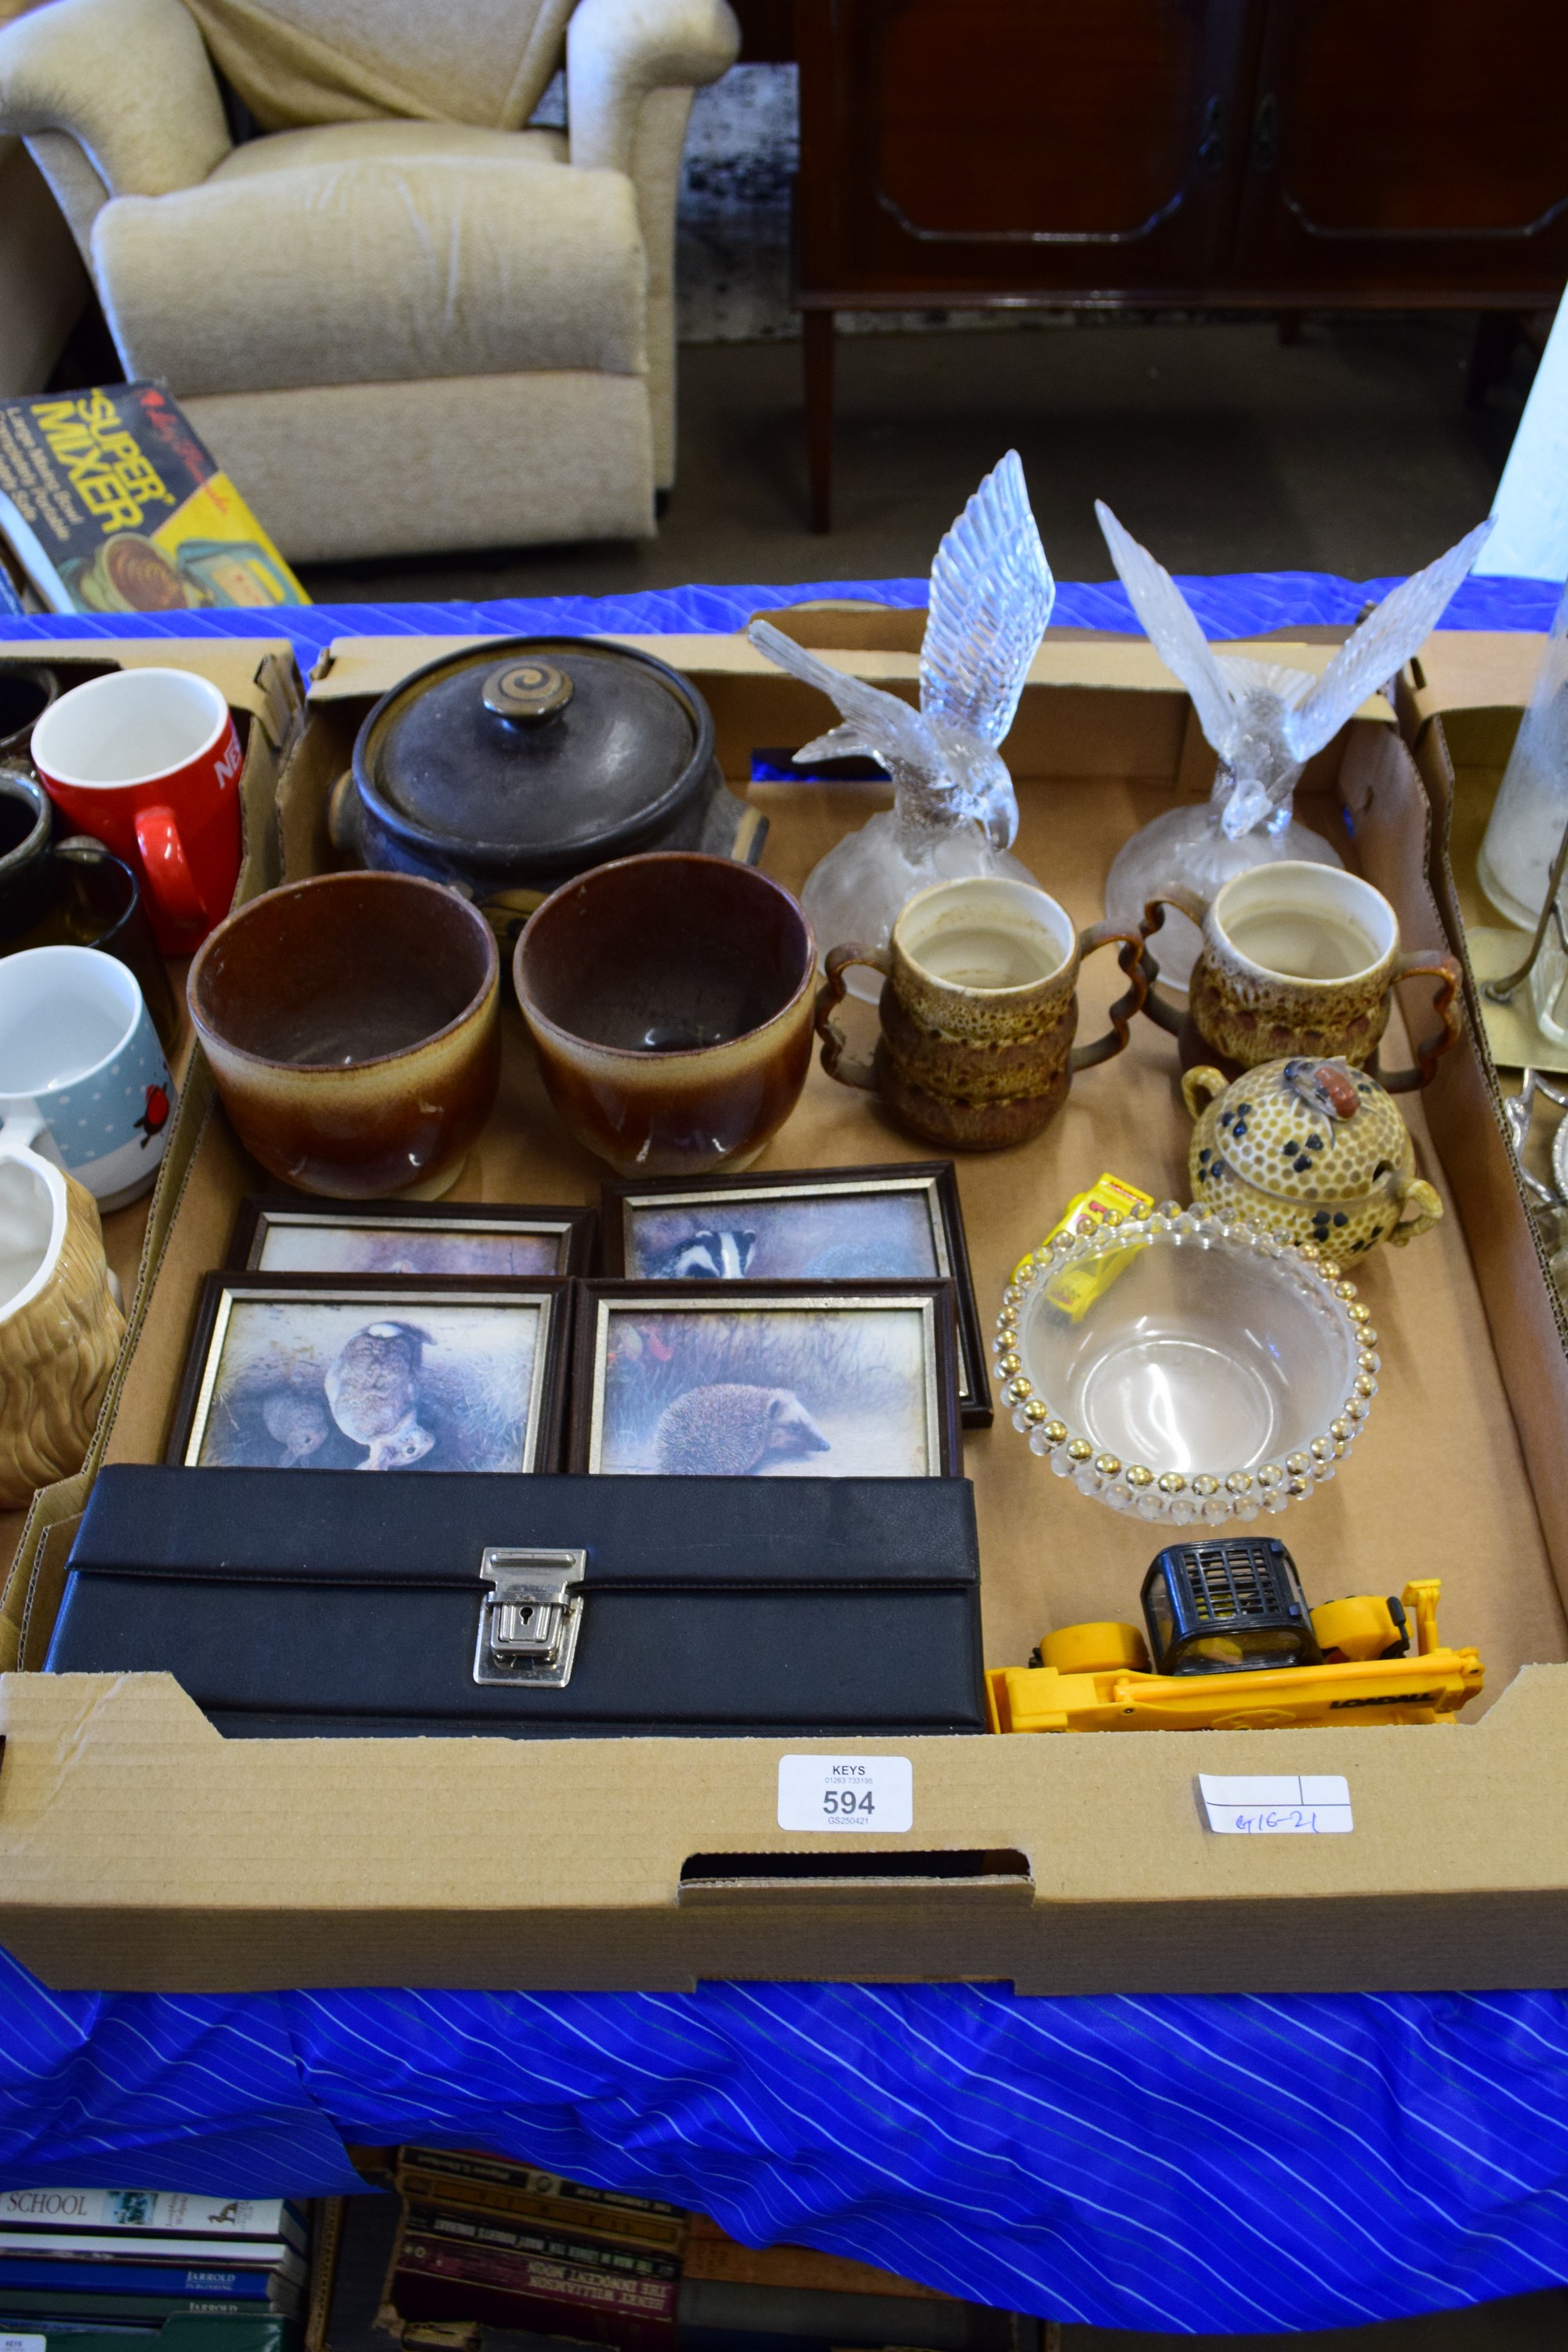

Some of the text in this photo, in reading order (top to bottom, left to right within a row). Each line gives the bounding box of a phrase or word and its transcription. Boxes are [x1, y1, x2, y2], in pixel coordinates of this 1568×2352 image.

[31, 400, 143, 533] MIXER
[1330, 1693, 1435, 1710] LOADALL
[833, 1766, 866, 1776] KEYS
[823, 1791, 875, 1814] 594
[7, 2193, 88, 2216] SCHOOL
